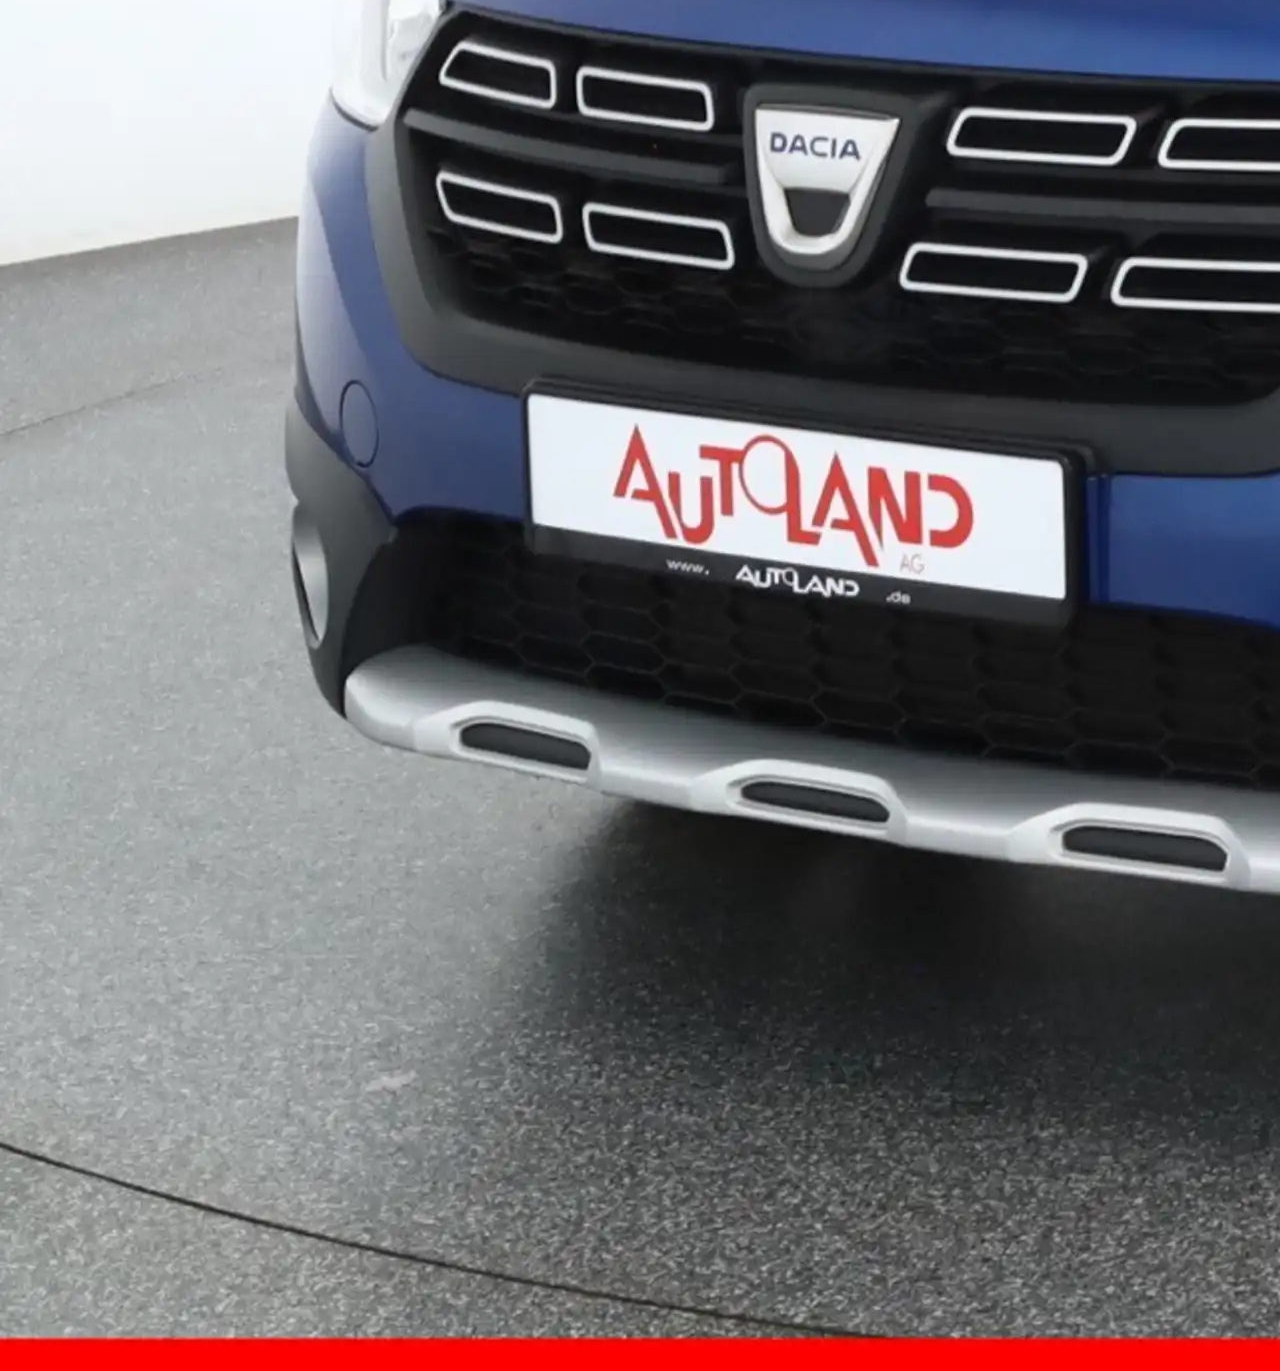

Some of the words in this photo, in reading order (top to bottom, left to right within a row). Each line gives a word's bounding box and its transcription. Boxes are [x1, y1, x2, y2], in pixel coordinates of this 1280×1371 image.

[769, 131, 862, 161] DACIA
[612, 423, 975, 567] AUTOLAND
[899, 553, 926, 574] AG
[735, 564, 860, 598] AUTOLAND
